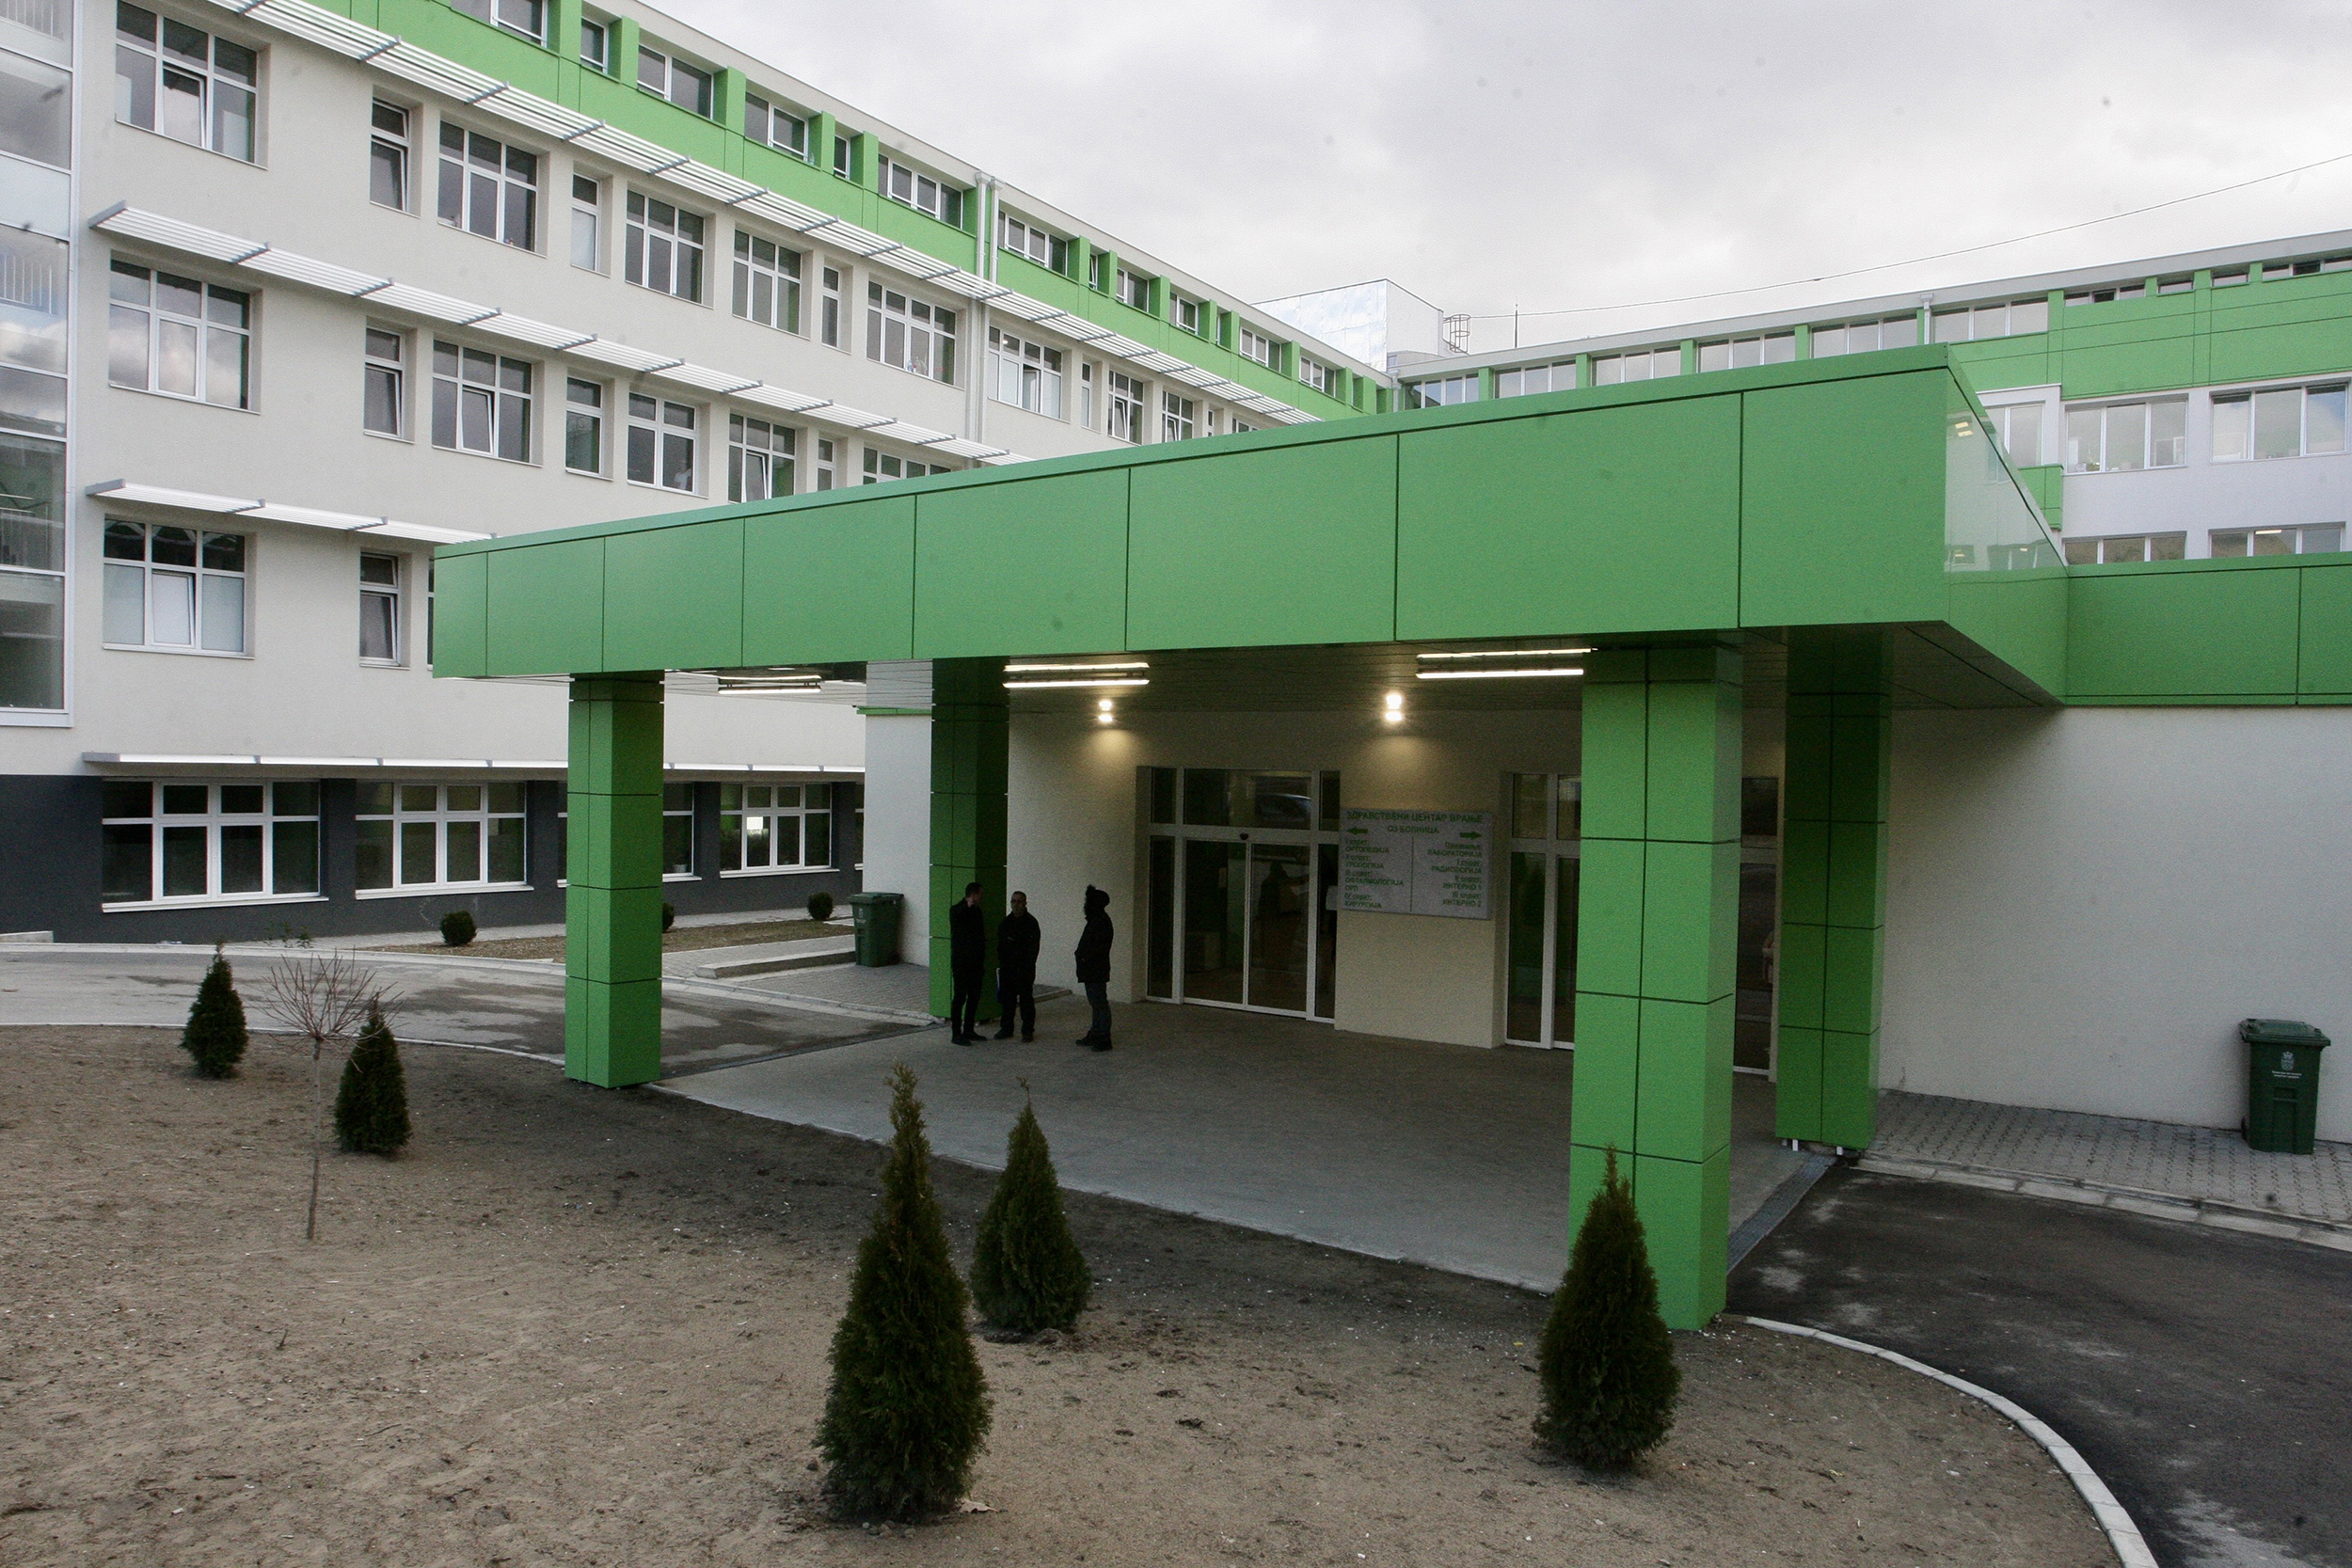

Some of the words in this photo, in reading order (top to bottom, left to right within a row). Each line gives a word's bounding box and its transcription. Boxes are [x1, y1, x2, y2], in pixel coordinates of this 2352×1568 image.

[1346, 811, 1408, 820] ЗДРАВСТВЕНИ
[1411, 813, 1446, 823] ЦЕНТАР
[1450, 815, 1483, 823] ВРАЊЕ
